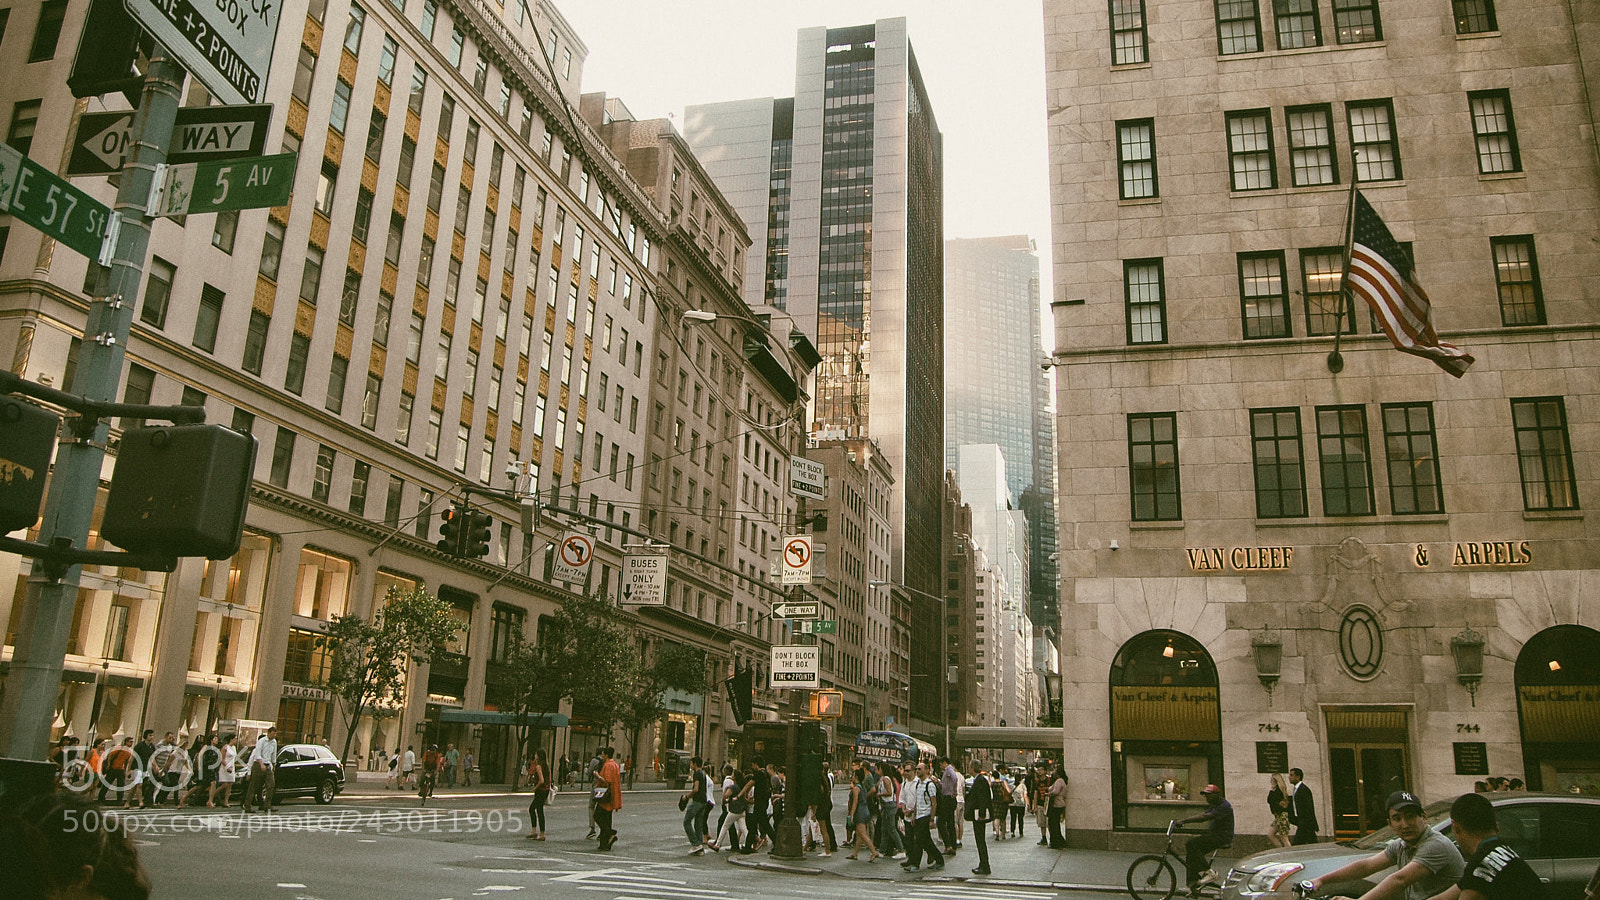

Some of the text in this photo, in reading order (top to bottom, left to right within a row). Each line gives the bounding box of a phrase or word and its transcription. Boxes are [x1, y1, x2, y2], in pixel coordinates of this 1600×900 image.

[209, 35, 256, 100] POINTS
[102, 125, 243, 155] ON WAY
[212, 167, 232, 205] 5
[12, 166, 34, 212] E
[40, 184, 78, 234] 57
[808, 464, 822, 474] BLOCK
[798, 470, 817, 480] THE BOX
[1186, 542, 1532, 570] VAN CLEEF & ARPELS
[631, 560, 657, 568] BUSES
[632, 575, 654, 583] ONLY
[817, 622, 821, 631] 5
[283, 686, 325, 699] BVLGARI
[1115, 691, 1217, 704] Van Cleef & Arpels
[1521, 691, 1546, 701] Van
[1549, 691, 1581, 701] Cleef
[1258, 724, 1281, 732] 744
[1457, 724, 1480, 733] 744
[857, 746, 902, 758] NEWSIES
[1402, 792, 1413, 801] NY
